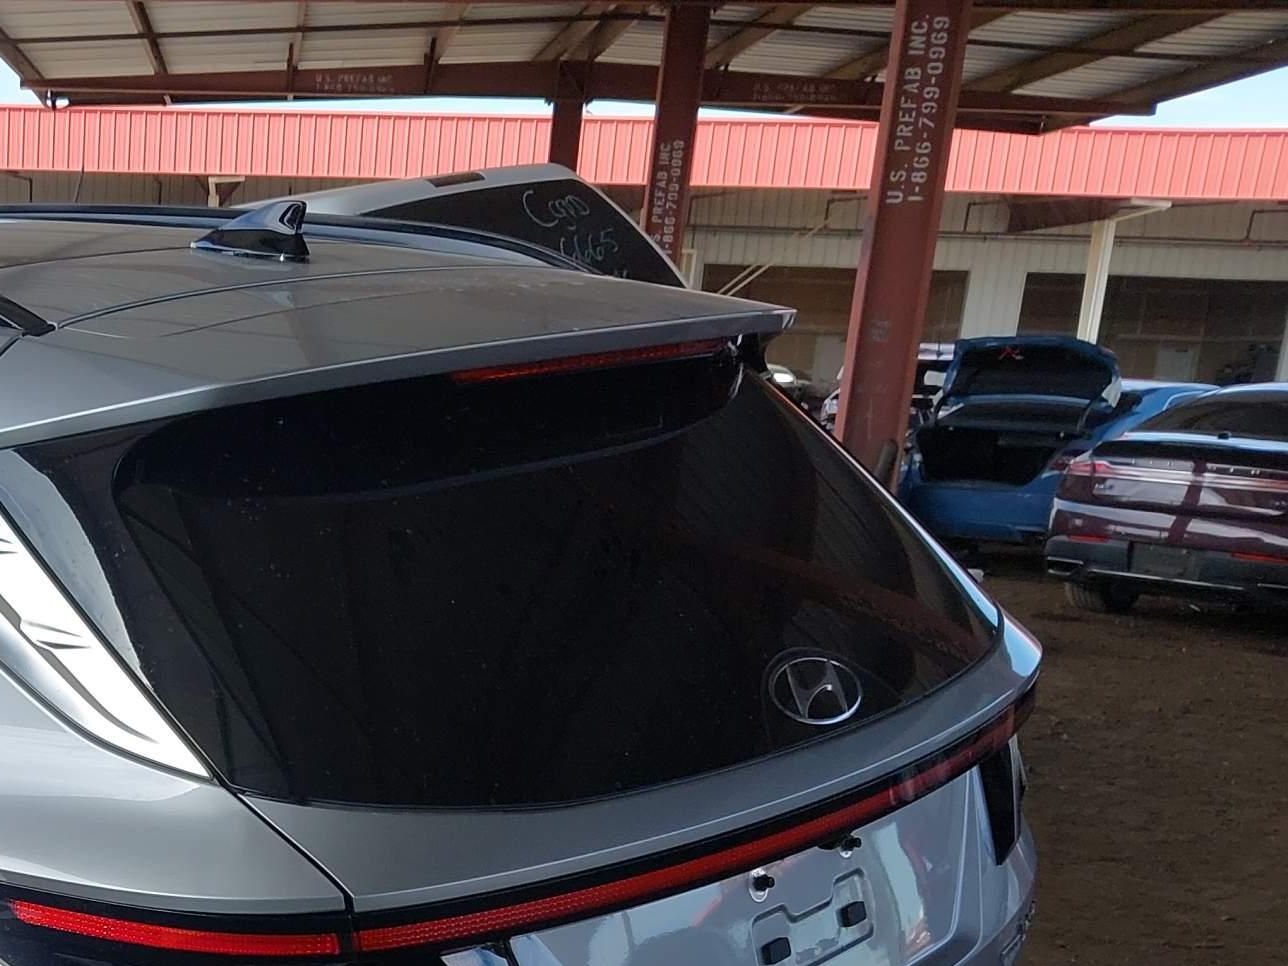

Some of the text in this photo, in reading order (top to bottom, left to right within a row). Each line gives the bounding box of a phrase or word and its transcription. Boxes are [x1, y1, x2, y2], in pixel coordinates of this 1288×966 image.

[651, 171, 669, 224] PREFAB
[885, 13, 930, 205] U.S. PREFAB INC.
[907, 15, 950, 202] 1-866-799-0969
